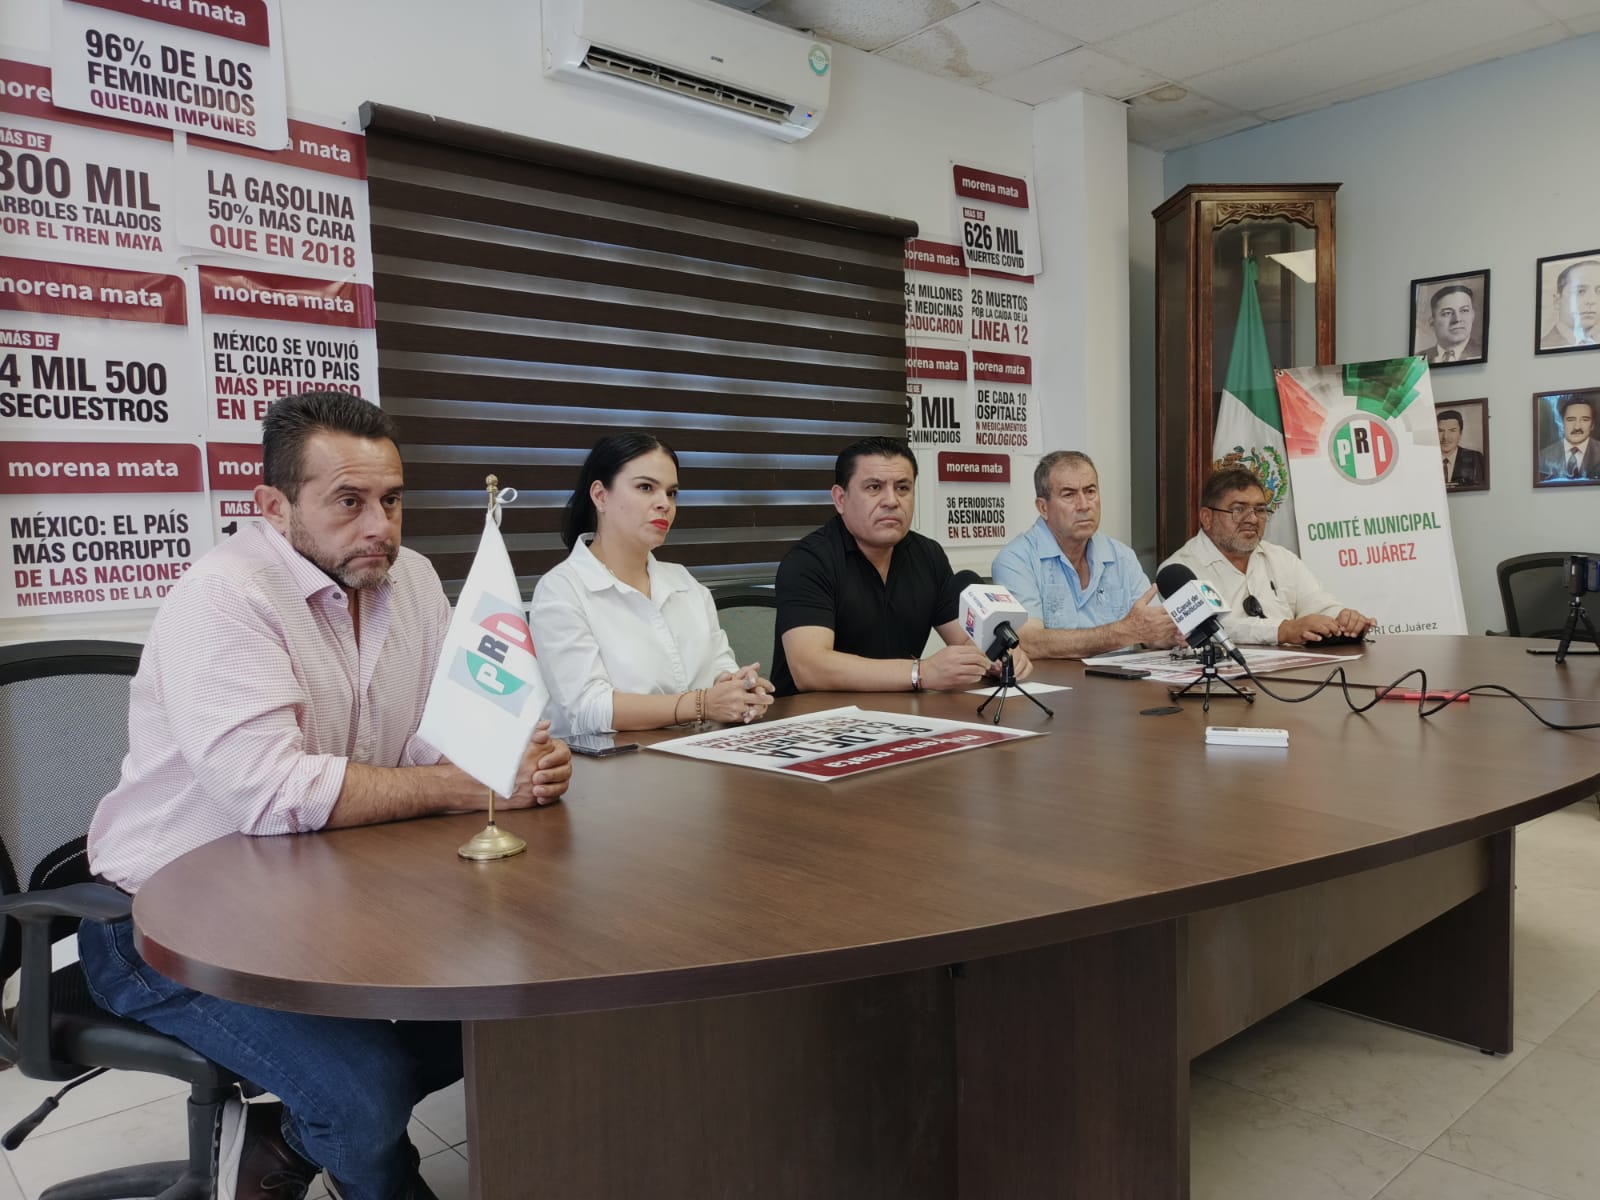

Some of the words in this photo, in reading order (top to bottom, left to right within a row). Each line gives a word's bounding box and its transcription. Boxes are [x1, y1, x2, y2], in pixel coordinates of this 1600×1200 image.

[189, 0, 246, 26] mata
[86, 29, 151, 69] 96%
[161, 45, 196, 79] DE
[205, 55, 253, 91] LOS
[87, 61, 255, 117] FEMINICIDIOS
[90, 89, 169, 119] QUEDAN
[174, 106, 256, 137] IMPUNES
[27, 134, 46, 149] DE
[299, 139, 351, 163] mata
[86, 163, 161, 212] MIL
[208, 170, 237, 199] LA
[244, 177, 355, 220] GASOLINA
[962, 178, 996, 193] morena
[997, 185, 1019, 198] mata
[83, 206, 162, 233] TALADOS
[208, 199, 253, 225] 50%
[259, 206, 301, 233] MÁS
[306, 217, 355, 242] CARA
[36, 221, 58, 239] EL
[62, 225, 109, 246] TREN
[115, 231, 163, 252] MAYA
[210, 224, 258, 252] QUE
[265, 233, 294, 258] EN
[301, 240, 356, 268] 2018
[964, 222, 993, 250] 626
[996, 227, 1023, 255] MIL
[937, 254, 960, 266] mata
[966, 249, 1000, 265] MUERTES
[1002, 255, 1024, 269] COVID
[100, 287, 163, 308] mata
[214, 285, 298, 307] morena
[304, 295, 355, 313] mata
[918, 284, 963, 302] MILLONES
[971, 289, 983, 305] 26
[986, 291, 1028, 311] MUERTOS
[915, 301, 964, 318] MEDICINAS
[985, 308, 993, 318] LA
[1, 330, 31, 346] MÁS
[35, 334, 54, 348] DE
[213, 329, 277, 354] MÉXICO
[283, 338, 302, 355] SE
[306, 340, 359, 360] VOLVIÓ
[1014, 324, 1028, 345] 12
[0, 353, 21, 388] 4
[32, 355, 97, 392] MIL
[106, 360, 167, 396] 500
[214, 353, 237, 373] EL
[243, 355, 316, 379] CUARTO
[322, 357, 360, 382] PAÍS
[936, 359, 960, 371] mata
[1005, 365, 1025, 375] mata
[215, 373, 257, 397] MÁS
[0, 392, 169, 423] SECUESTROS
[217, 398, 246, 420] EN
[254, 400, 272, 420] E
[978, 390, 990, 403] DE
[992, 391, 1015, 405] CADA
[1017, 393, 1027, 406] 10
[921, 396, 960, 429] MIL
[975, 404, 1027, 421] OSPITALES
[906, 430, 961, 443] EMINICIDIOS
[982, 422, 1027, 432] MEDICAMENTOS
[1336, 427, 1386, 467] PRI
[9, 461, 110, 477] morena
[117, 459, 179, 477] mata
[219, 460, 263, 476] mor
[946, 462, 980, 473] morena
[981, 463, 1003, 474] mata
[946, 498, 956, 509] 36
[958, 497, 1005, 509] PERIODISTAS
[10, 512, 106, 539] MÉXICO:
[113, 515, 139, 536] EL
[144, 509, 189, 535] PAÍS
[948, 510, 1005, 524] ASESINADOS
[1307, 516, 1362, 542] COMITÉ
[1364, 511, 1441, 537] MUNICIPAL
[948, 527, 959, 538] EN
[961, 527, 971, 538] EL
[972, 526, 1005, 538] SEXENIO
[13, 539, 66, 565] MÁS
[73, 538, 192, 563] CORRUPTO
[1338, 549, 1363, 568] CD.
[1366, 542, 1417, 565] JUÁREZ
[15, 569, 42, 588] DE
[50, 566, 88, 586] LAS
[17, 588, 105, 607] MIEMBROS
[110, 584, 129, 601] DE
[134, 585, 152, 599] LA
[476, 620, 528, 694] PRI
[726, 734, 821, 754] MEDIA
[754, 746, 825, 759] LA
[809, 735, 878, 749] DE
[890, 734, 982, 752] mrena
[824, 751, 895, 768] mata
